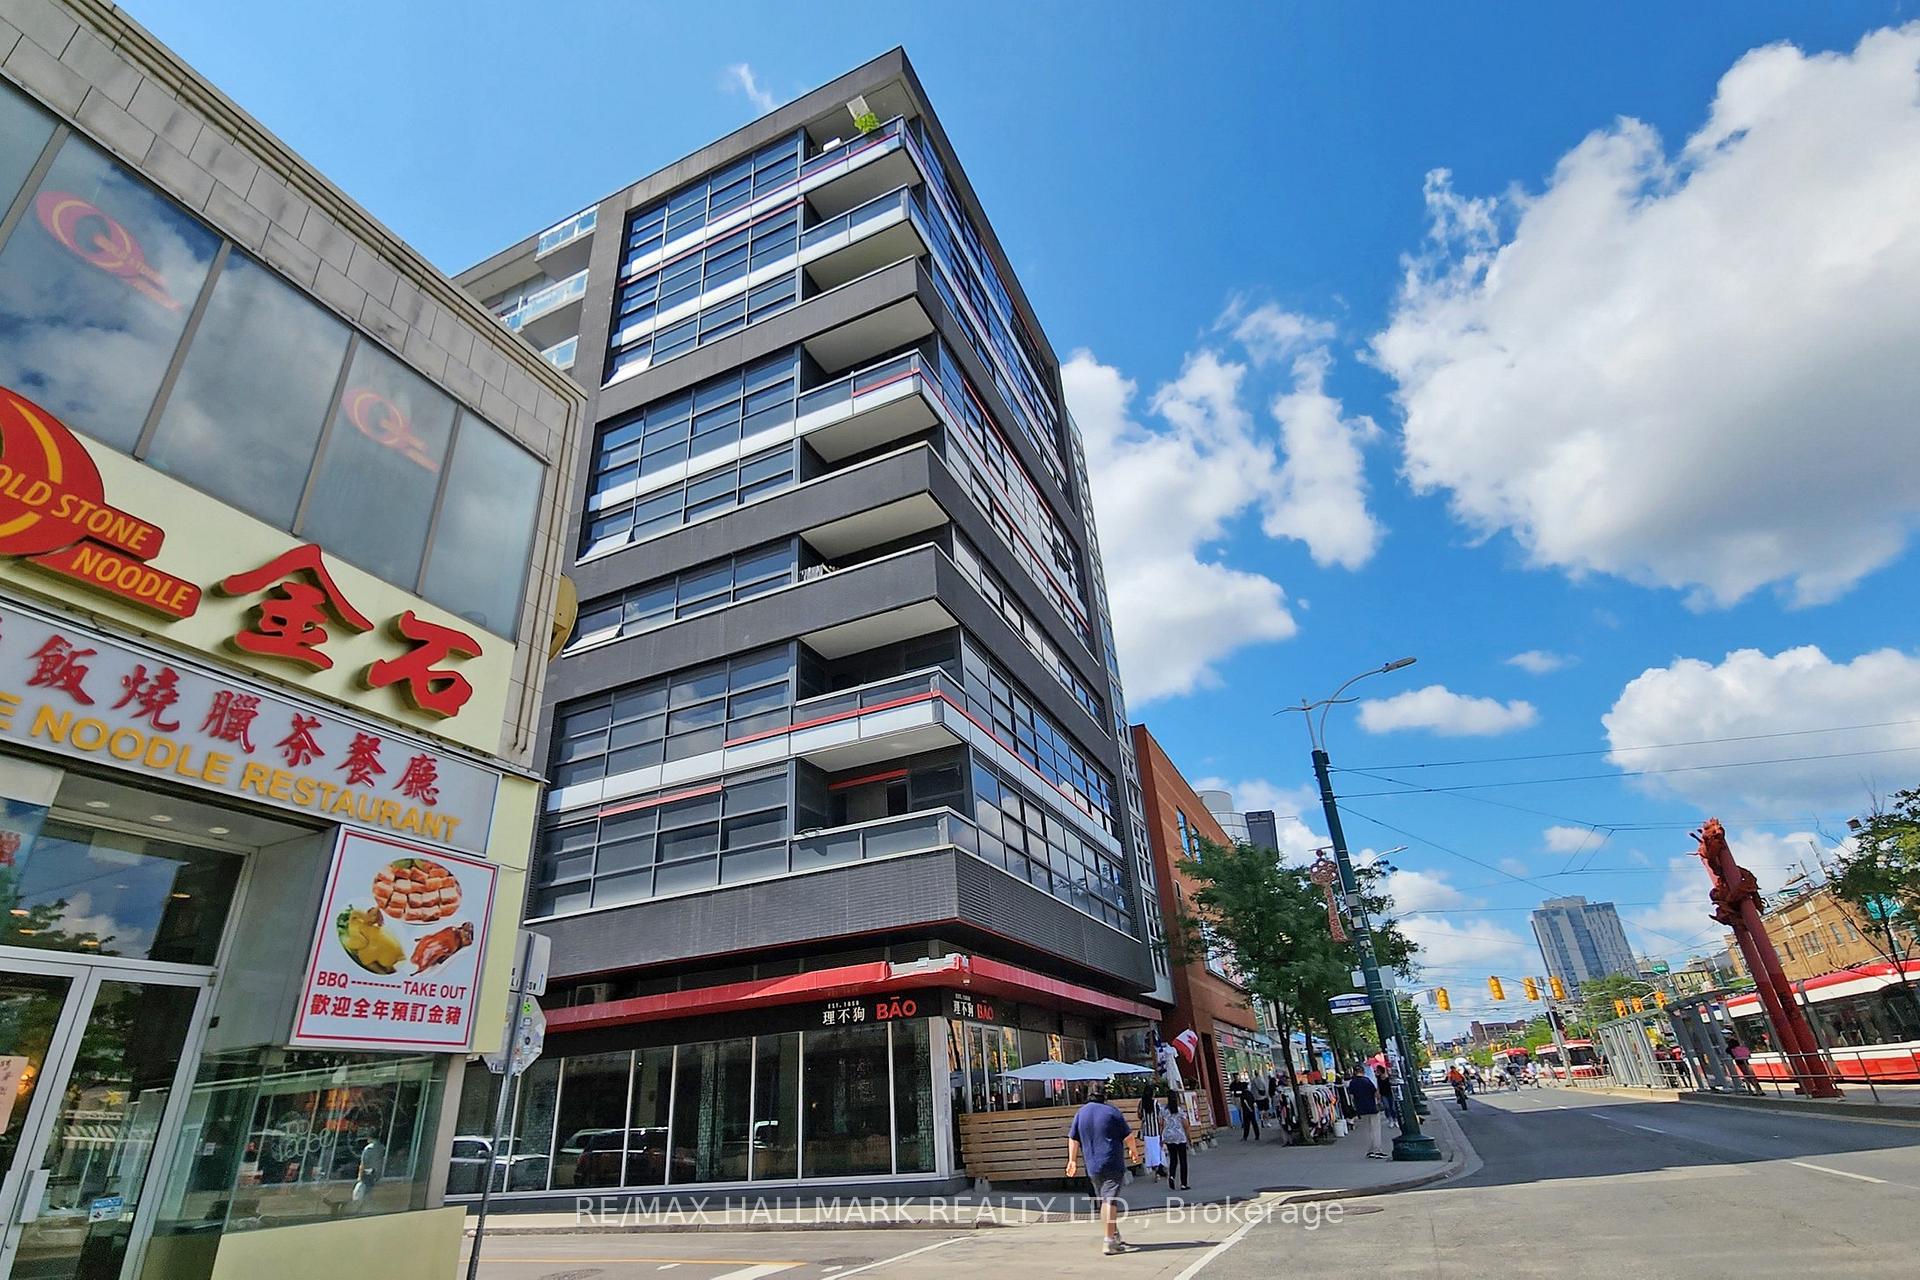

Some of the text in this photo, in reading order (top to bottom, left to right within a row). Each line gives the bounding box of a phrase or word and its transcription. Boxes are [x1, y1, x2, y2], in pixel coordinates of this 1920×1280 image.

[0, 464, 153, 550] OLD STONE
[71, 547, 193, 610] NOODLE
[222, 544, 482, 720] 金石
[0, 620, 439, 806] 飯燒臘茶餐廳
[30, 704, 235, 785] NOODLE
[241, 761, 460, 842] RESTAURANT
[310, 994, 461, 1025] 歡迎全年預訂金豬
[317, 971, 467, 1000] BBQ TAKE OUT
[822, 1006, 865, 1026] 理不狗
